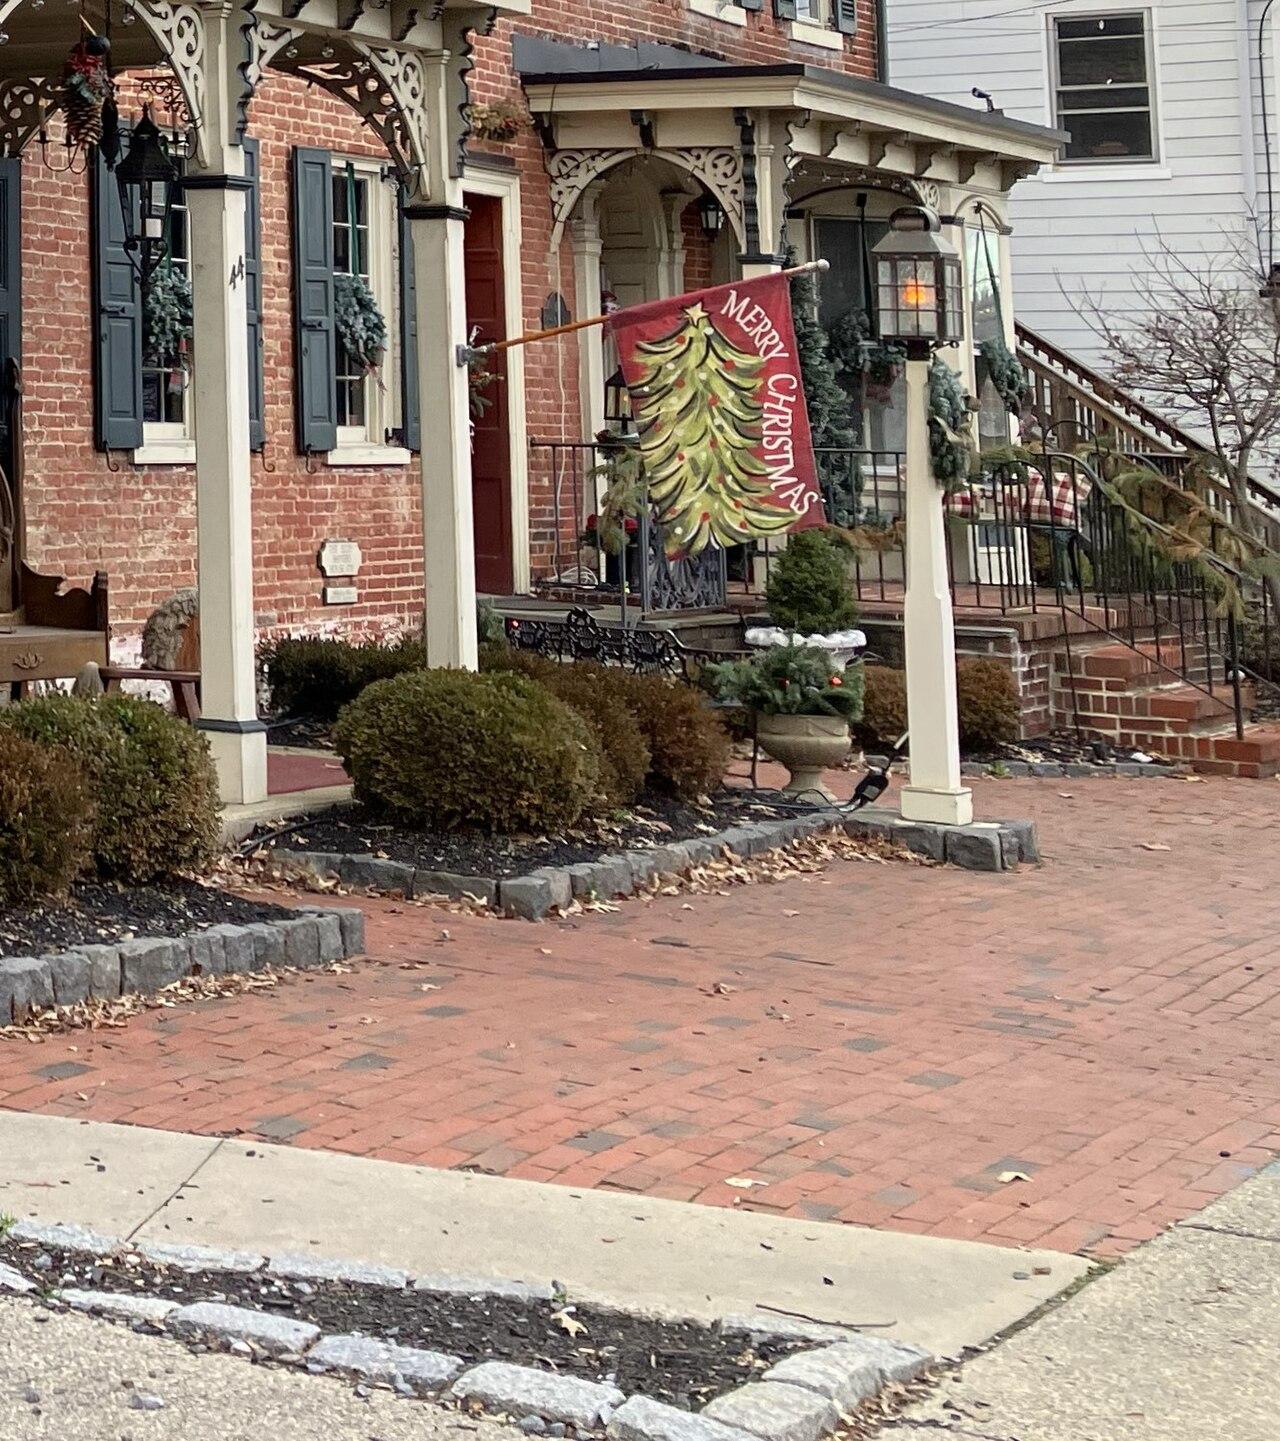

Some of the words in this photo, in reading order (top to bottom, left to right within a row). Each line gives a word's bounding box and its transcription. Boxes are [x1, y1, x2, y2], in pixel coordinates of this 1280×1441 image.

[228, 255, 245, 291] 44
[720, 289, 790, 362] MERRY
[762, 373, 819, 515] CHRISTMAS
